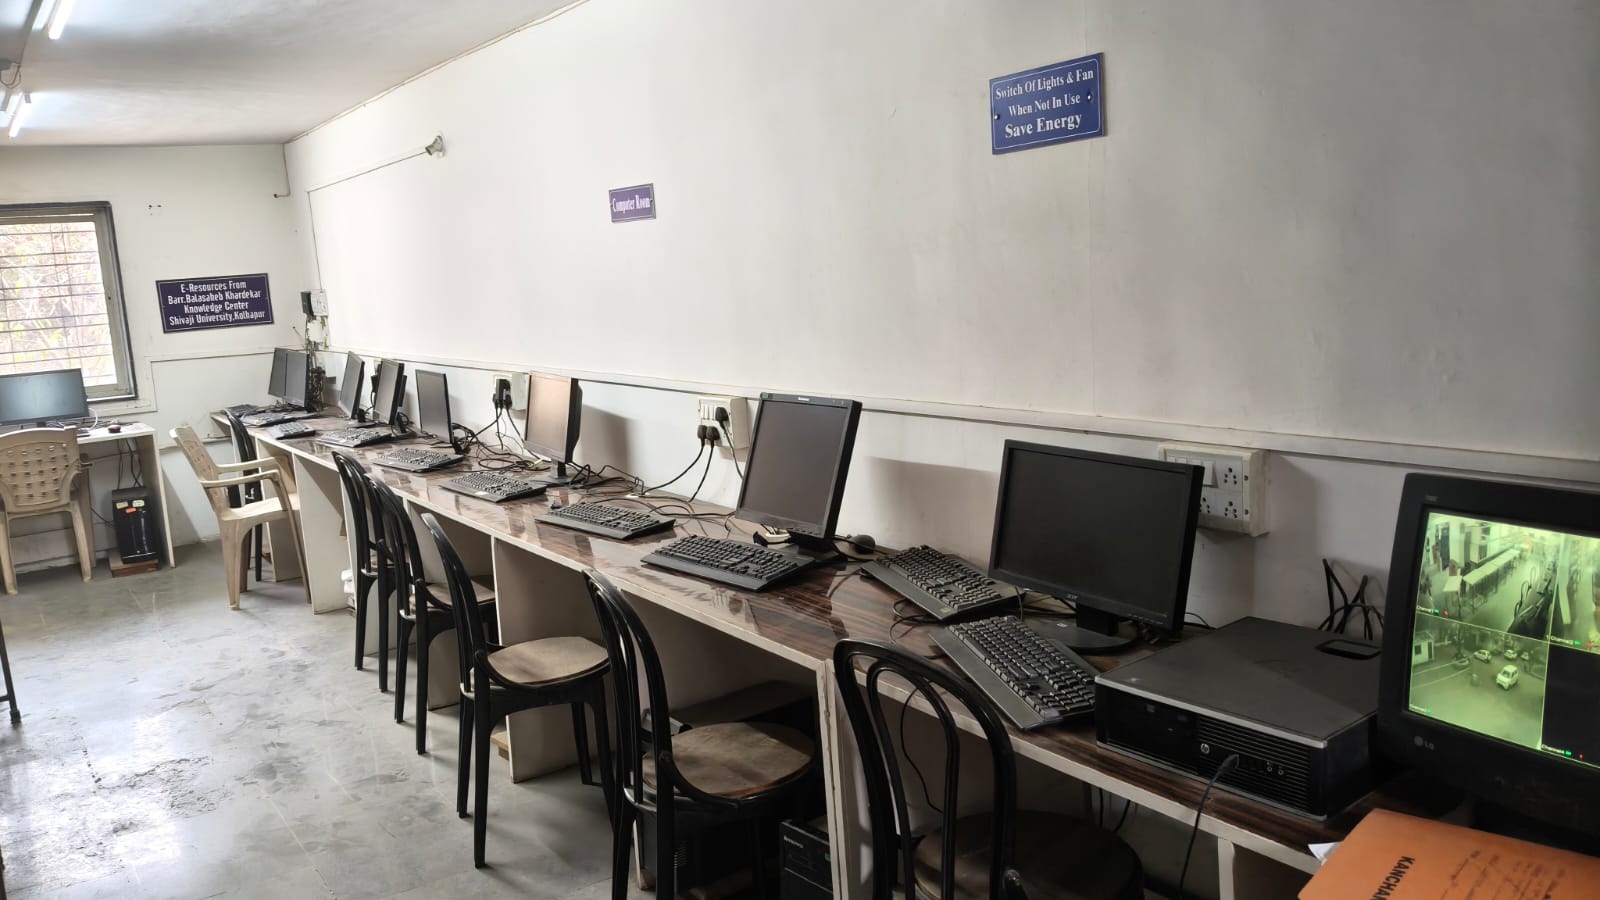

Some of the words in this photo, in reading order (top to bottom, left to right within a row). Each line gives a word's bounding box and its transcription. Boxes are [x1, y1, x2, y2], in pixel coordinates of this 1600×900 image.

[995, 83, 1023, 99] Switch
[1024, 78, 1036, 93] Of
[1037, 75, 1065, 91] Lights
[1066, 71, 1074, 84] &
[1076, 69, 1094, 82] Fan
[1008, 103, 1033, 117] When
[1034, 99, 1050, 112] Not
[1052, 96, 1062, 109] In
[1064, 93, 1080, 106] Use
[1005, 123, 1033, 139] Save
[1036, 114, 1082, 132] Energy
[635, 195, 650, 209] Room
[180, 282, 227, 293] E-Resources
[228, 280, 247, 290] From
[225, 289, 261, 301] Khardekar
[184, 302, 223, 314] Knowledge
[224, 301, 249, 311] Center
[169, 314, 195, 326] Shivaji
